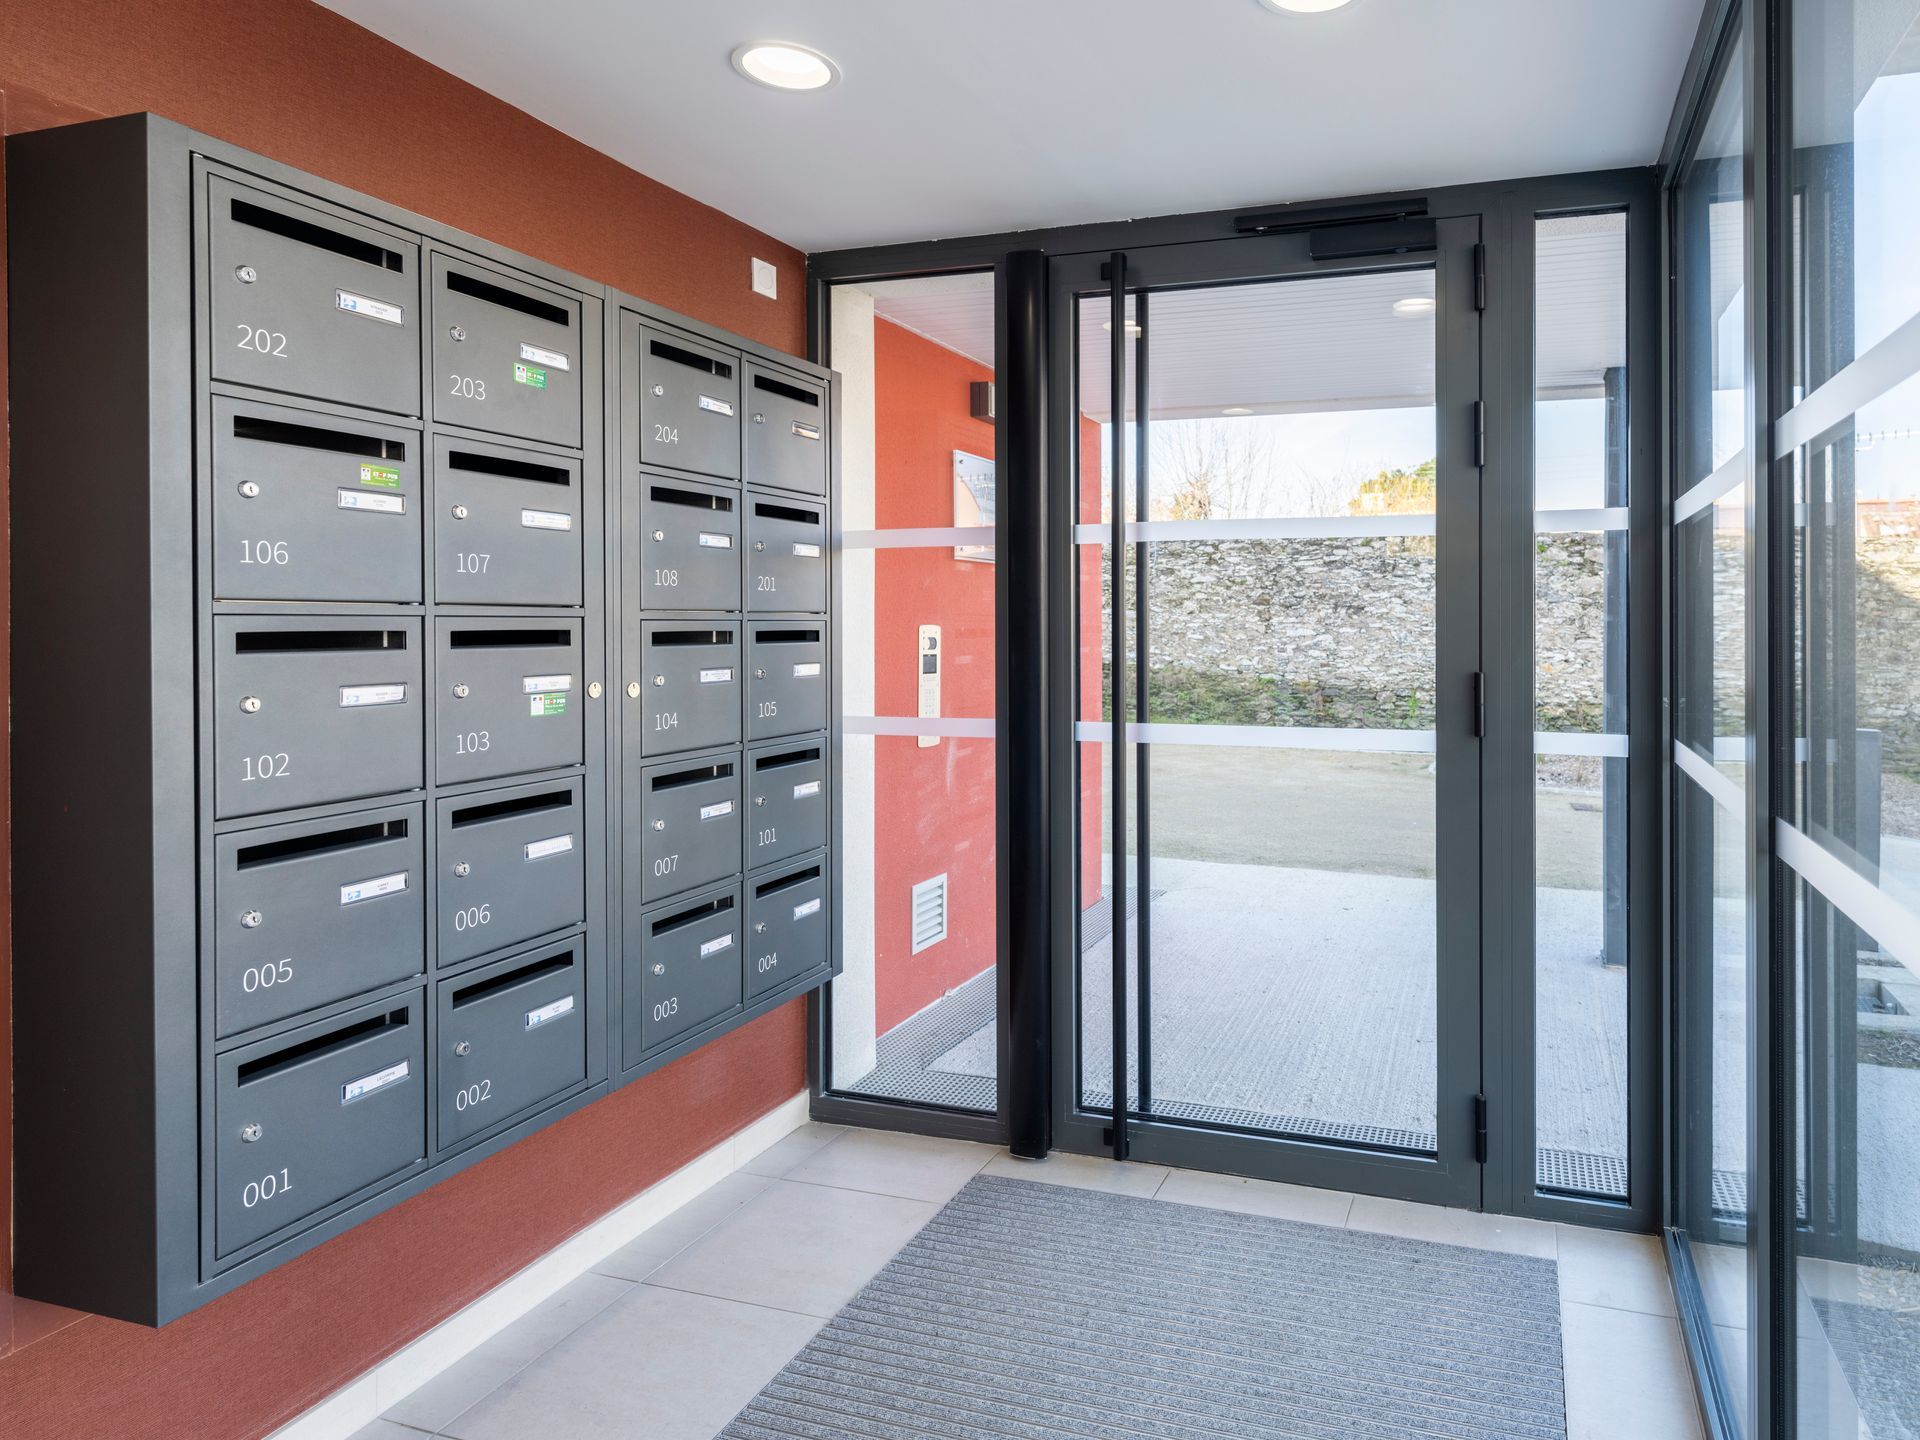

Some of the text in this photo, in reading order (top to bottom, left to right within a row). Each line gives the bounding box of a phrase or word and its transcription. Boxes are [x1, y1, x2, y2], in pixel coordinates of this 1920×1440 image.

[237, 324, 288, 358] 202
[450, 374, 486, 401] 203
[654, 425, 679, 445] 204
[239, 539, 289, 565] 106
[456, 552, 491, 574] 107
[654, 569, 678, 587] 108
[757, 575, 777, 592] 201
[655, 711, 678, 731] 104
[758, 701, 777, 718] 105
[455, 730, 490, 755] 103
[241, 752, 291, 782] 102
[758, 827, 777, 846] 101
[654, 854, 679, 877] 007
[455, 903, 491, 931] 006
[758, 952, 778, 973] 004
[242, 958, 293, 993] 005
[653, 997, 678, 1022] 003
[456, 1079, 492, 1111] 002
[243, 1167, 293, 1208] 001
